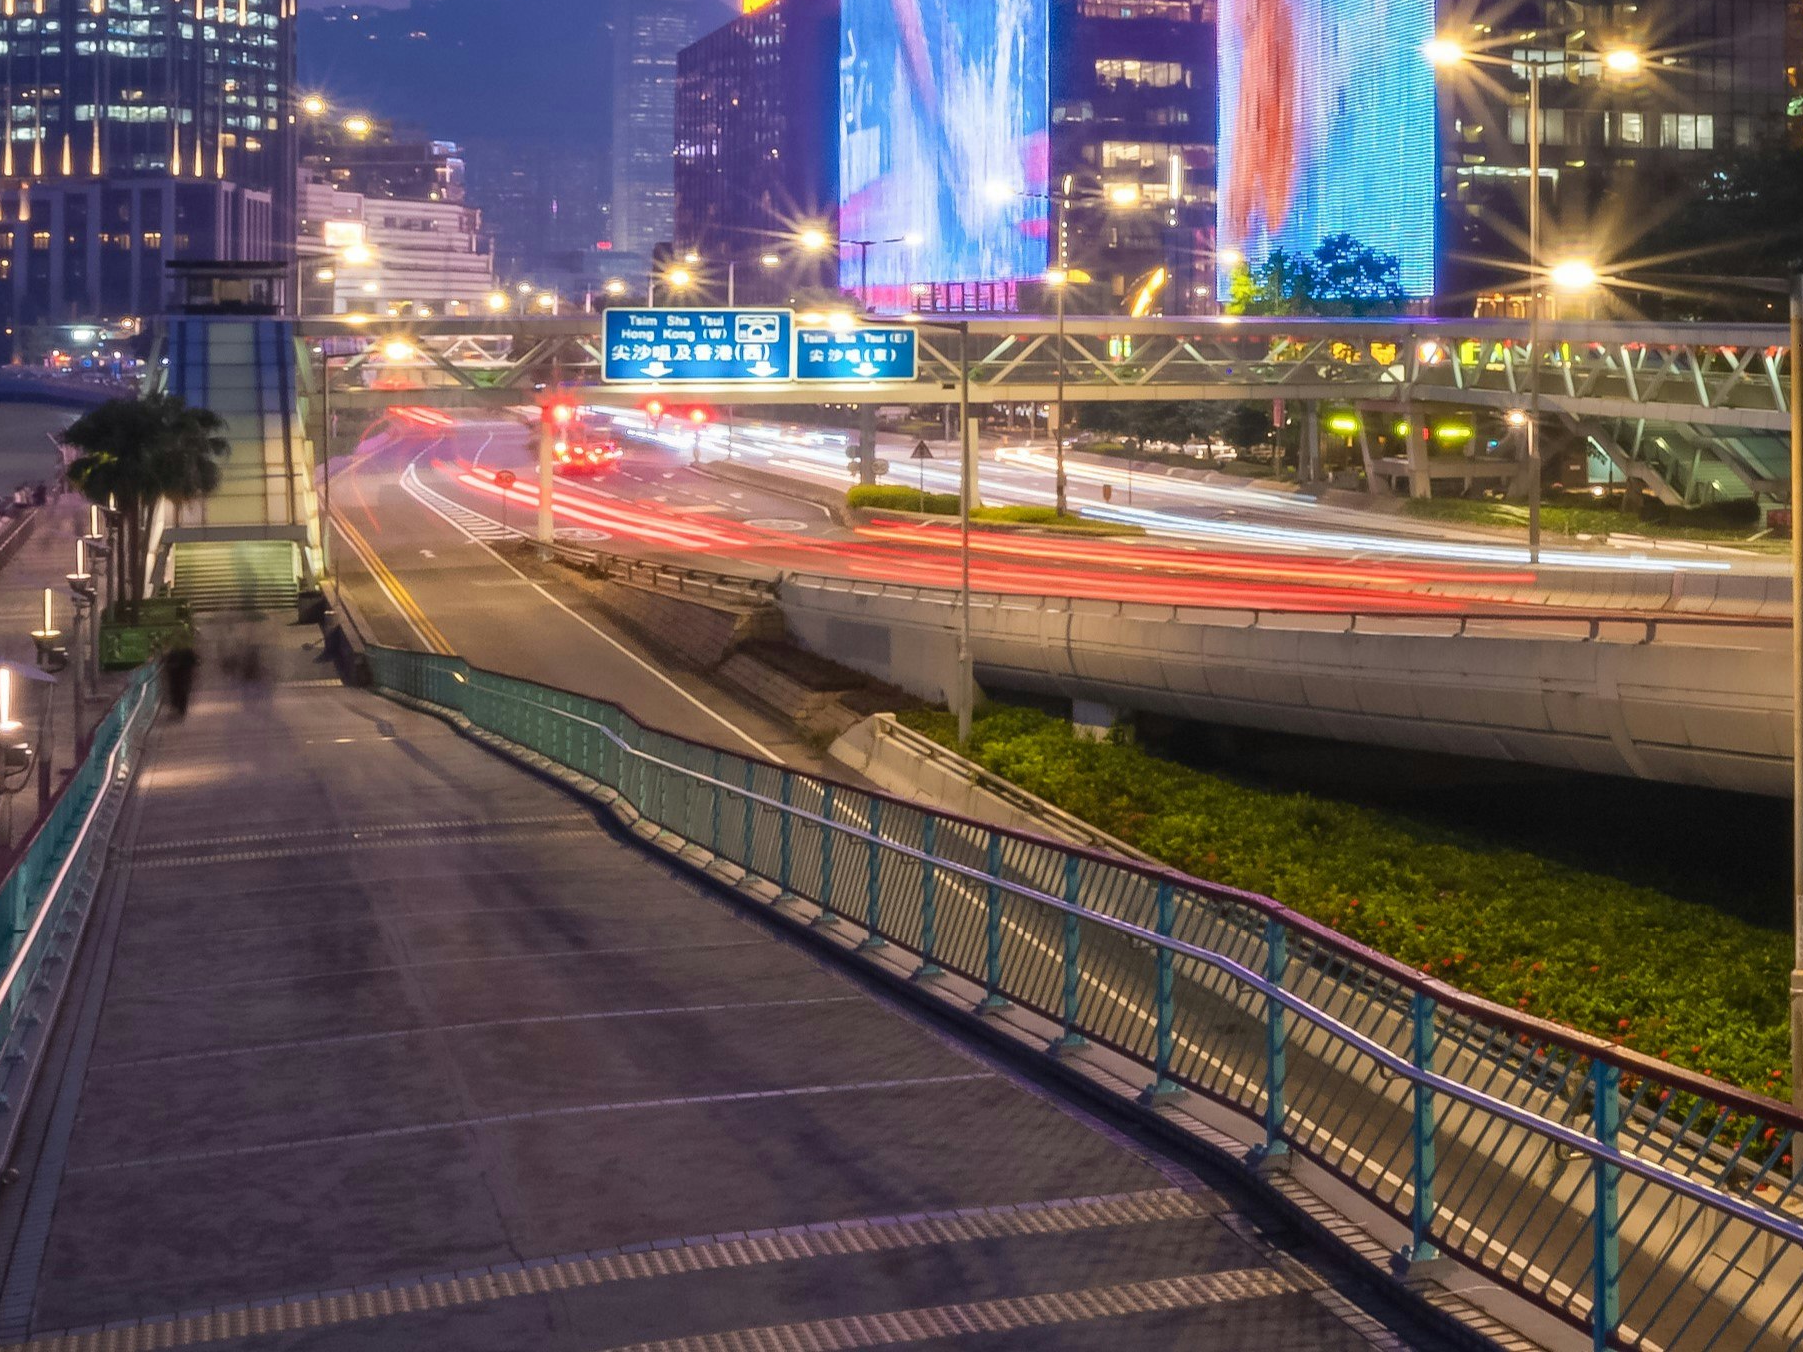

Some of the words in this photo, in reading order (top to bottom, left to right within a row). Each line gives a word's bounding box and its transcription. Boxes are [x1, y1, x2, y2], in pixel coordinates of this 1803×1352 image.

[629, 315, 658, 326] Tsim
[667, 315, 691, 326] Sha
[699, 315, 724, 326] Tsui
[621, 329, 655, 342] Hong
[663, 329, 696, 342] Kong
[702, 329, 728, 339] (W)
